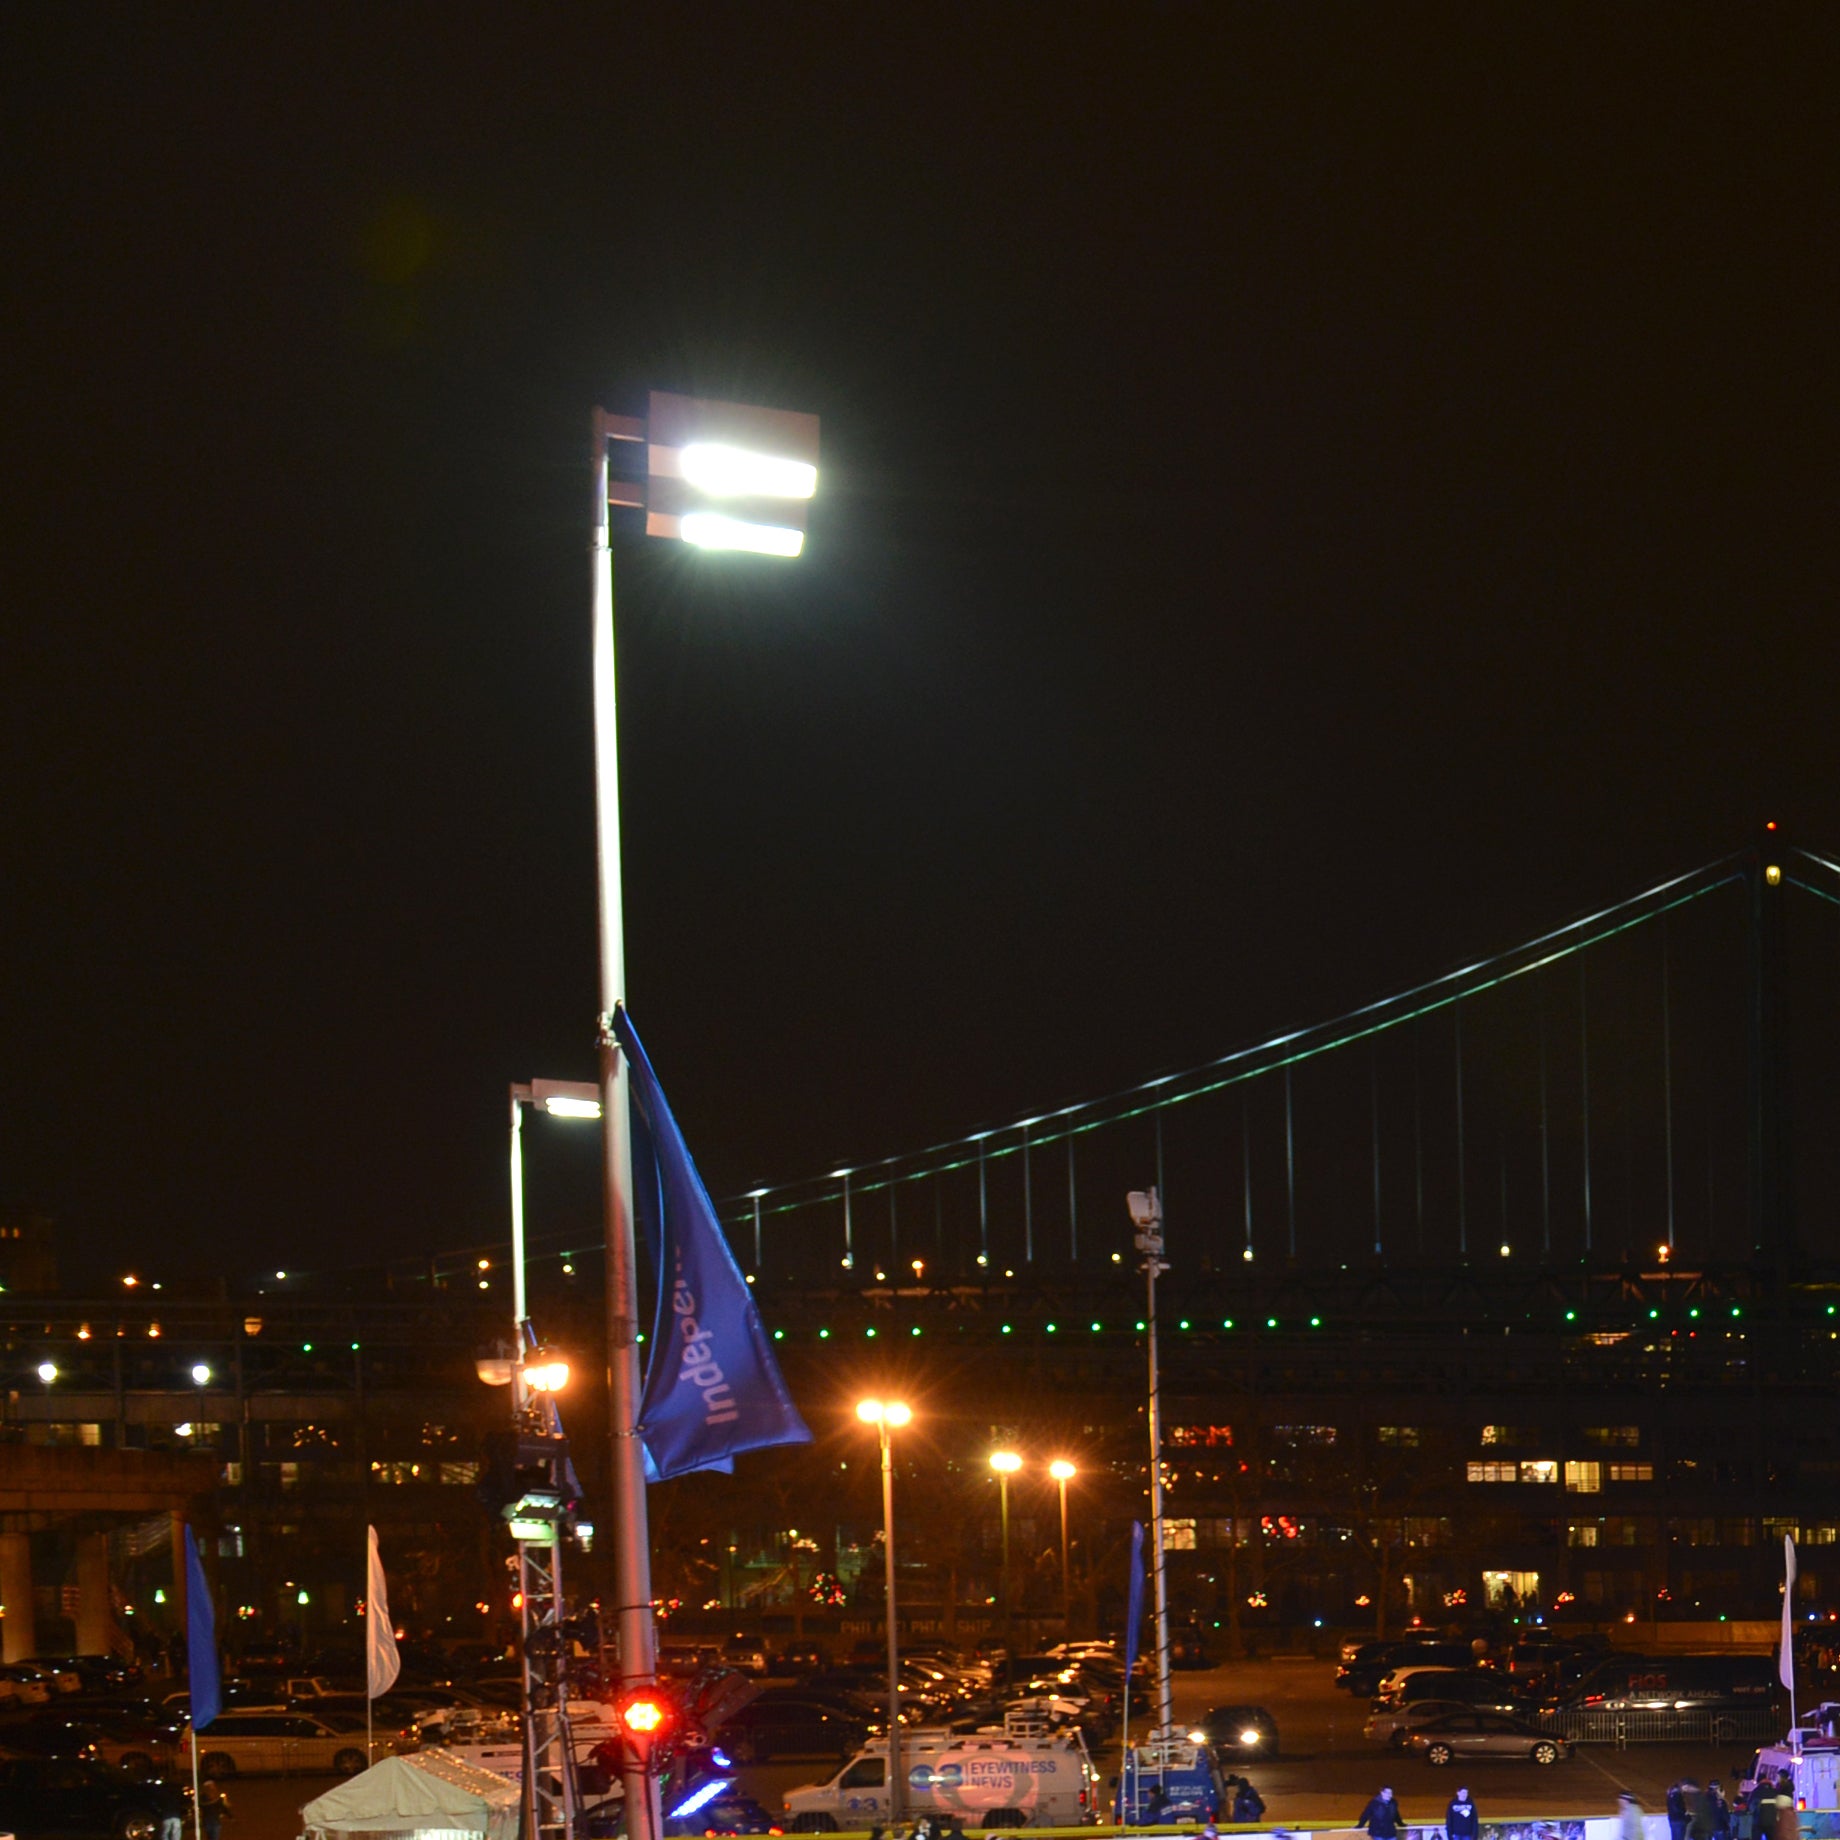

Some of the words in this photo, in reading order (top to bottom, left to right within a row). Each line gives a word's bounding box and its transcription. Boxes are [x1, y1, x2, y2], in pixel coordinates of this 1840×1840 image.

[840, 1619, 944, 1634] PHILAELPHIA
[971, 1760, 1057, 1774] EYEWITNESS
[971, 1776, 1013, 1788] NEWS
